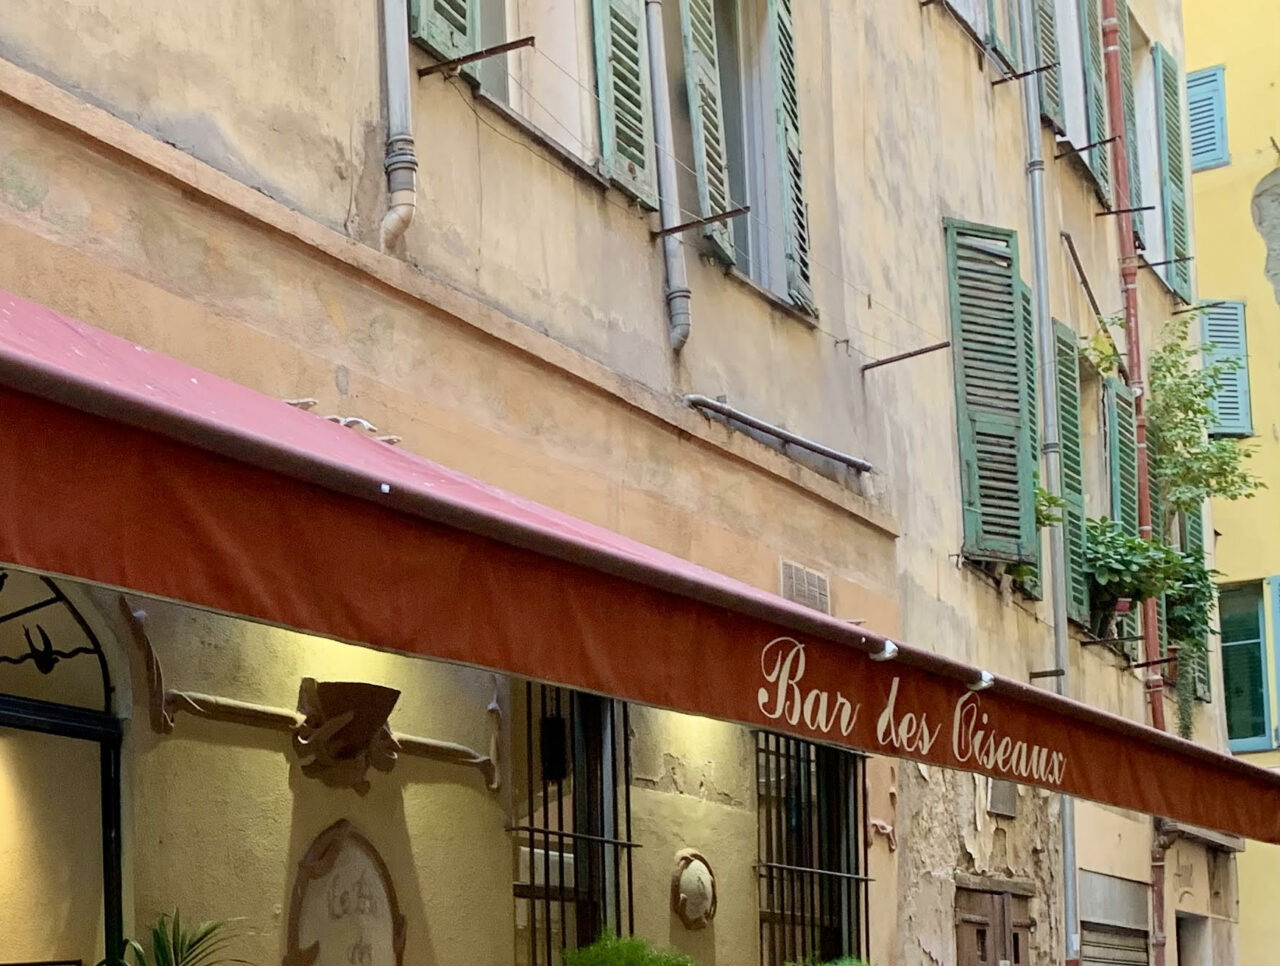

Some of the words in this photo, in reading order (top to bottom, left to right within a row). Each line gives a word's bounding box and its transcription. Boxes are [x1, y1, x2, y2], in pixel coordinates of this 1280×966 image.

[757, 636, 860, 736] Bar
[877, 677, 941, 755] des
[953, 690, 1067, 785] Oiseaux
